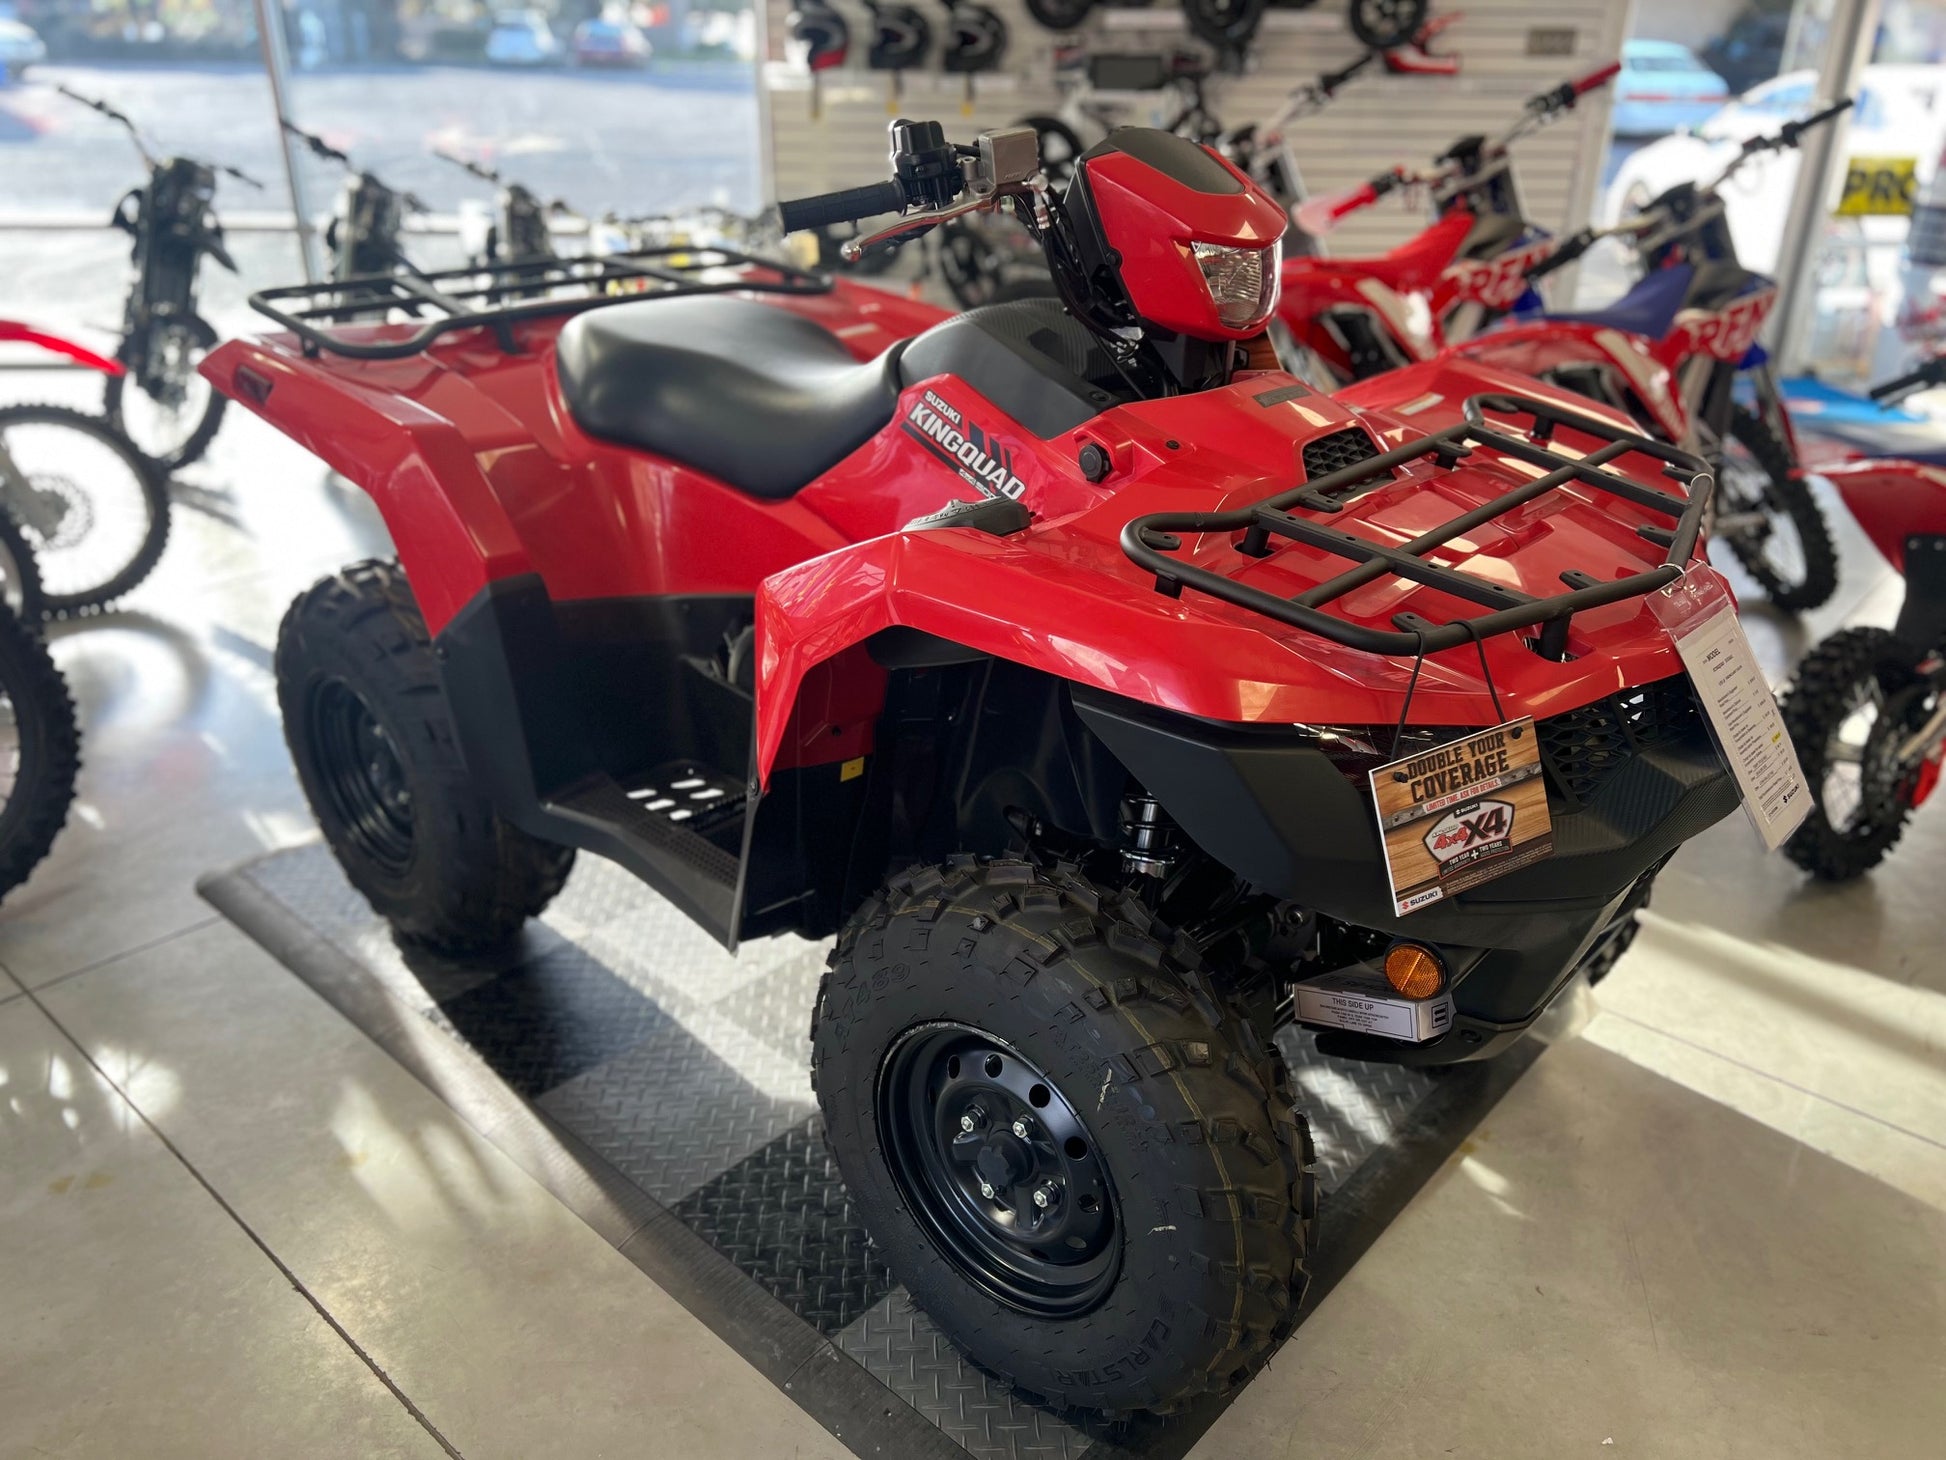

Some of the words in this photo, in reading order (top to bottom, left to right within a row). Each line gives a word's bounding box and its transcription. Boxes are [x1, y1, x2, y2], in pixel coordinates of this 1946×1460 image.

[924, 390, 962, 424] SUZUKI
[909, 402, 1026, 501] KINGQUAD
[1407, 745, 1464, 780] DOUBLE
[1467, 731, 1506, 758] YOUR
[1410, 749, 1510, 803] COVERAGE
[1460, 803, 1479, 813] SUZUKI
[1409, 890, 1439, 907] SUZUKI
[1332, 997, 1348, 1008] THIS
[1348, 999, 1363, 1010] SIDE
[1364, 1001, 1375, 1012] UP
